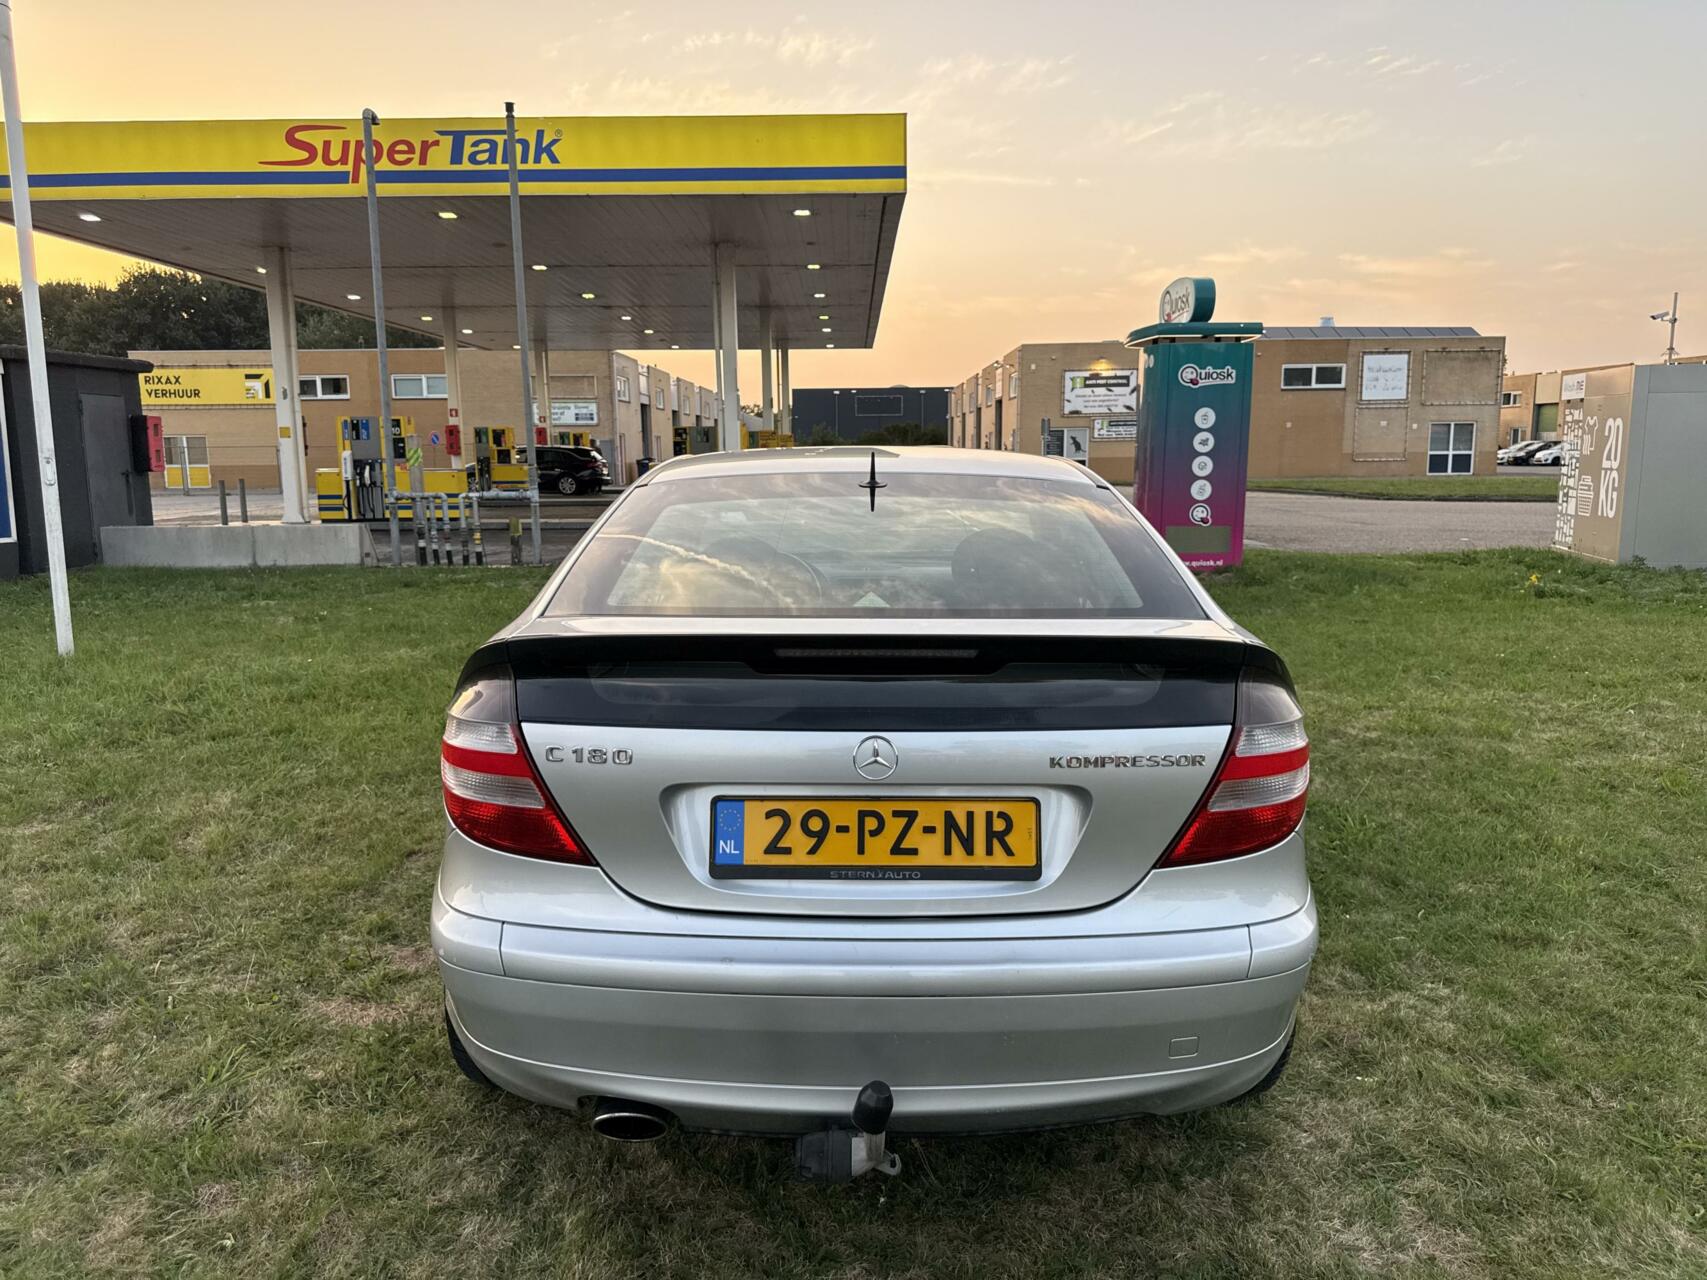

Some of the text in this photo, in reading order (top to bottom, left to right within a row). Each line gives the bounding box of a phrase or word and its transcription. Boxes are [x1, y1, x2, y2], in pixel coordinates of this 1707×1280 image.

[1163, 287, 1190, 321] Quiosk
[144, 375, 182, 385] RIXAX
[1180, 365, 1234, 386] Quiosk
[146, 388, 201, 399] VERHUUR
[1601, 417, 1623, 469] 20
[1598, 470, 1619, 518] KG
[545, 745, 633, 765] C 180
[1049, 753, 1206, 769] KOMPRESSOR
[763, 807, 1016, 857] 29-PZ-NR
[719, 839, 740, 854] NL
[830, 870, 921, 879] STERN AUTO
